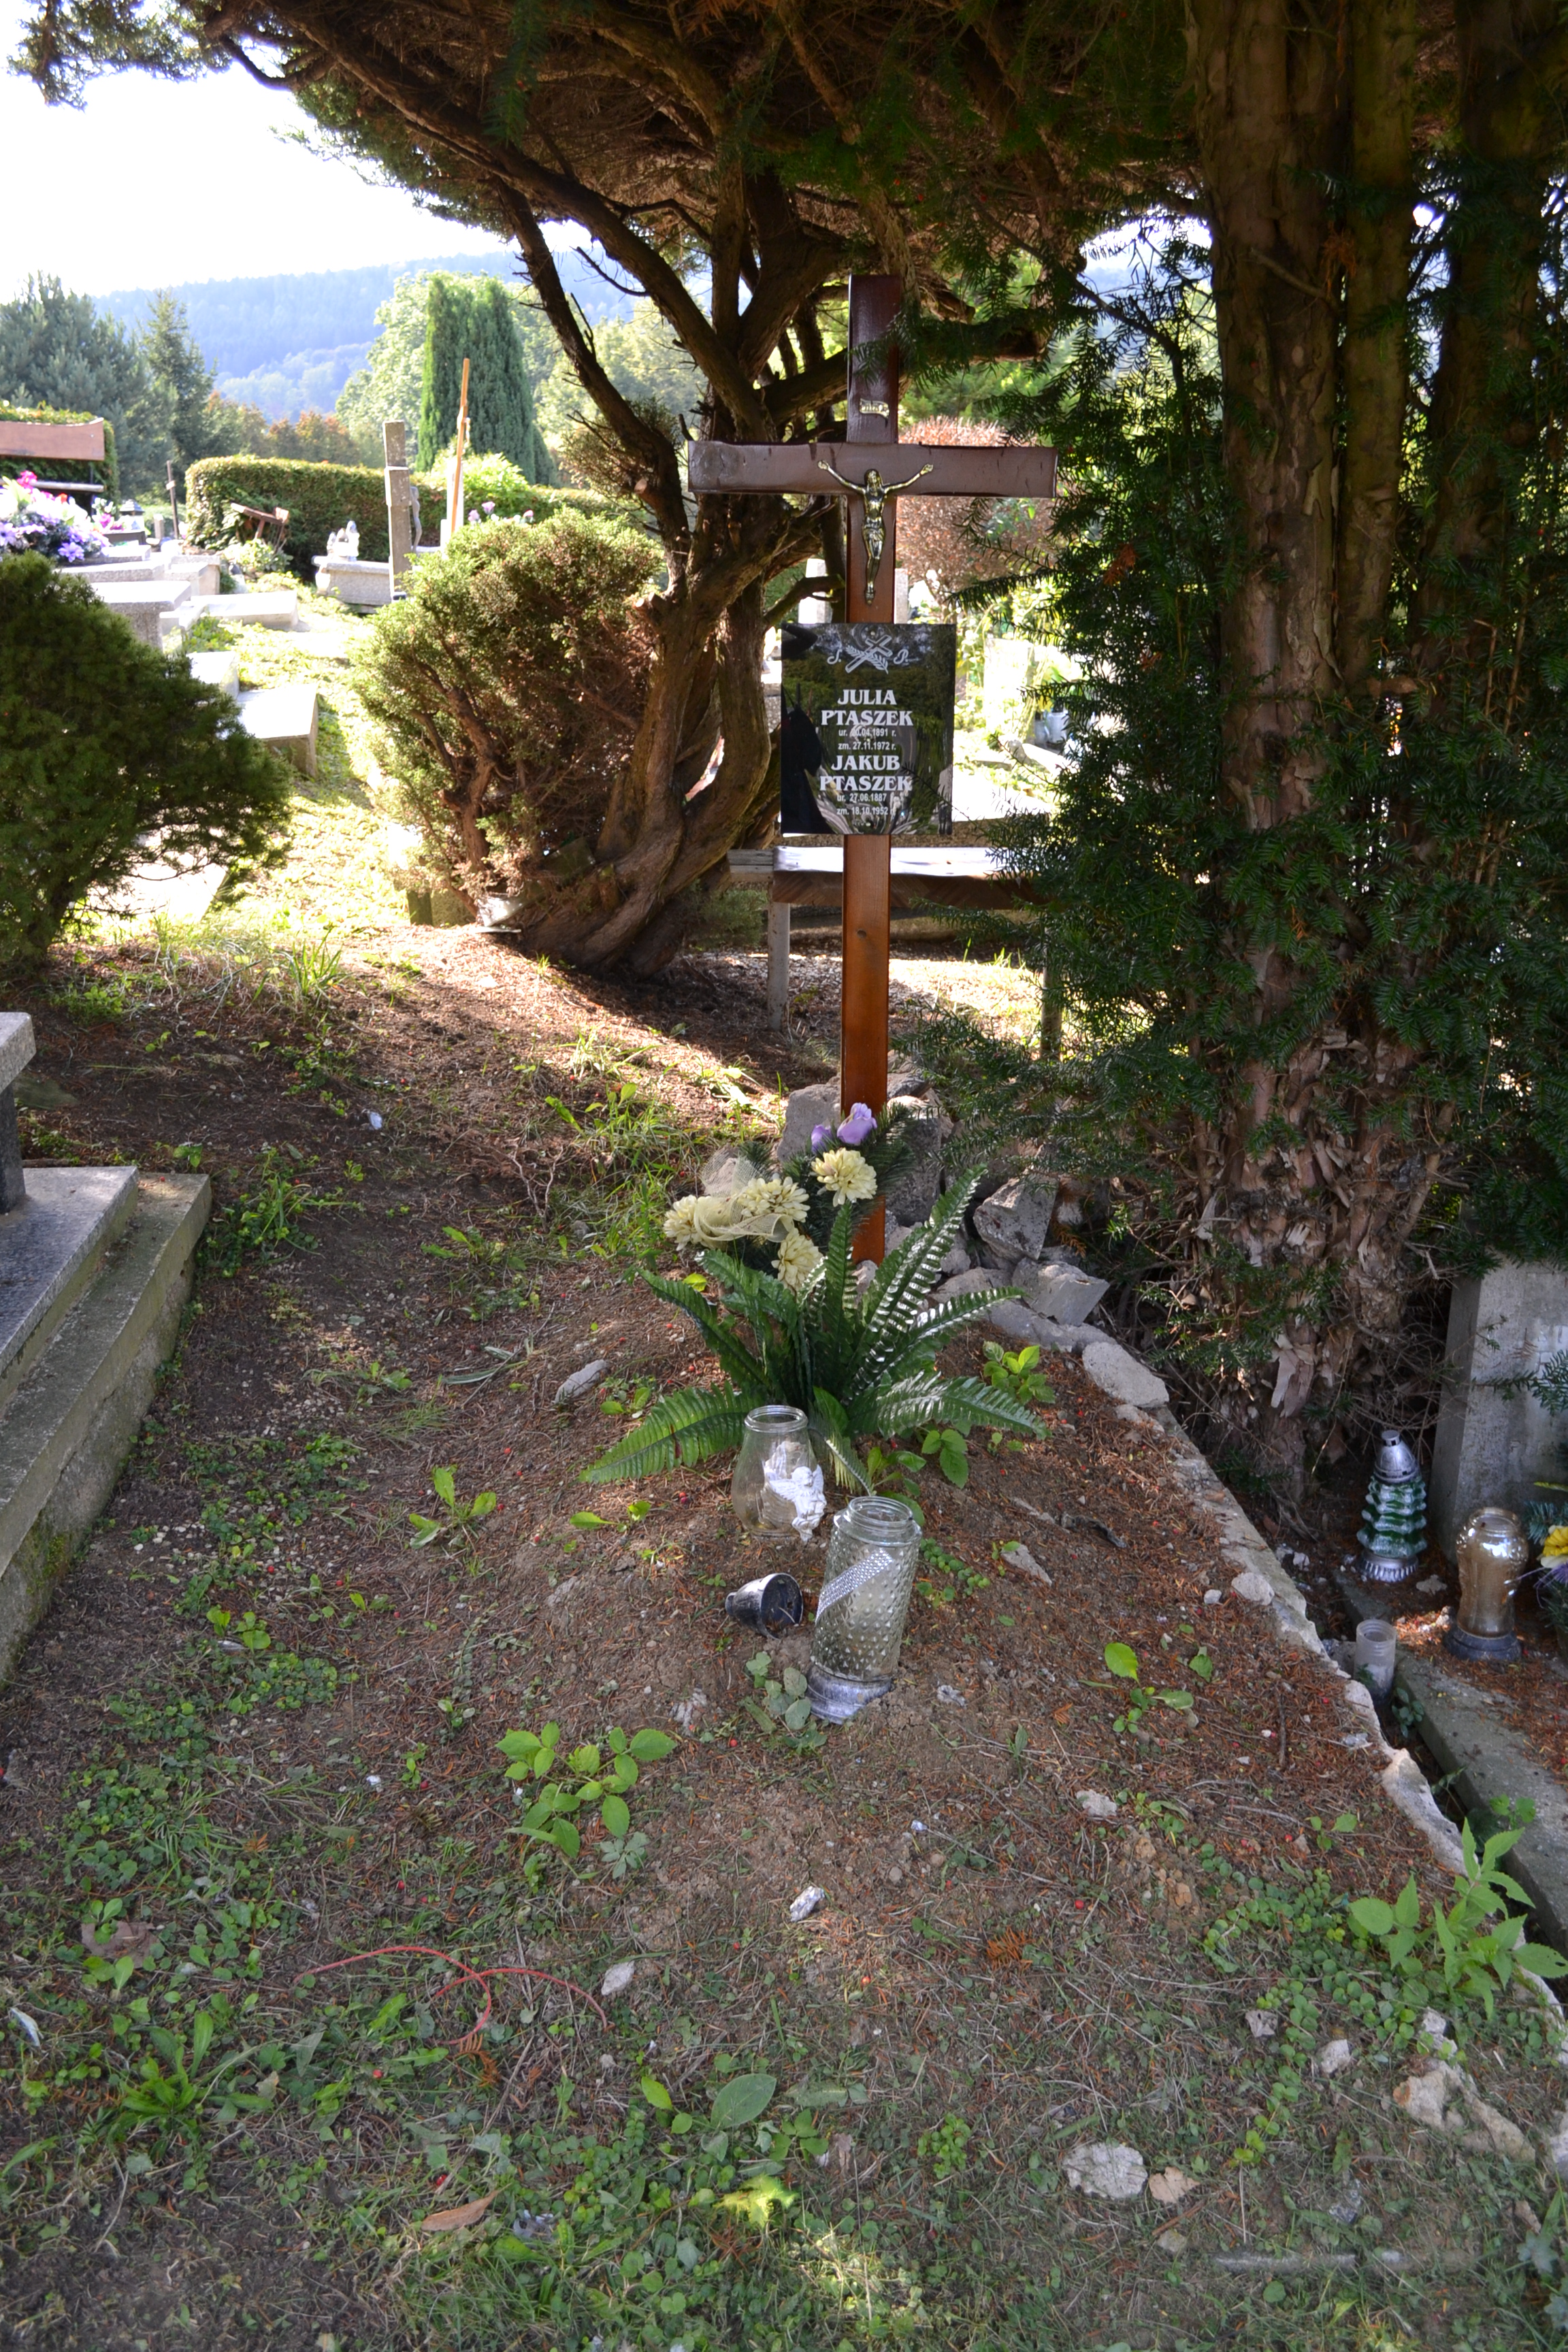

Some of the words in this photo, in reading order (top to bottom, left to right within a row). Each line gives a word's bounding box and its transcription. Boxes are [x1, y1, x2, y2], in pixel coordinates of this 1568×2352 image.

[893, 649, 909, 664] P.
[837, 689, 897, 705] JULIA
[821, 710, 914, 725] PTASZEK
[853, 742, 890, 750] 27.11.1972
[830, 755, 900, 770] JAKUB
[819, 776, 913, 791] PTASZEK
[849, 793, 887, 802] 27.06.1887
[851, 806, 888, 815] 18.10.1952
